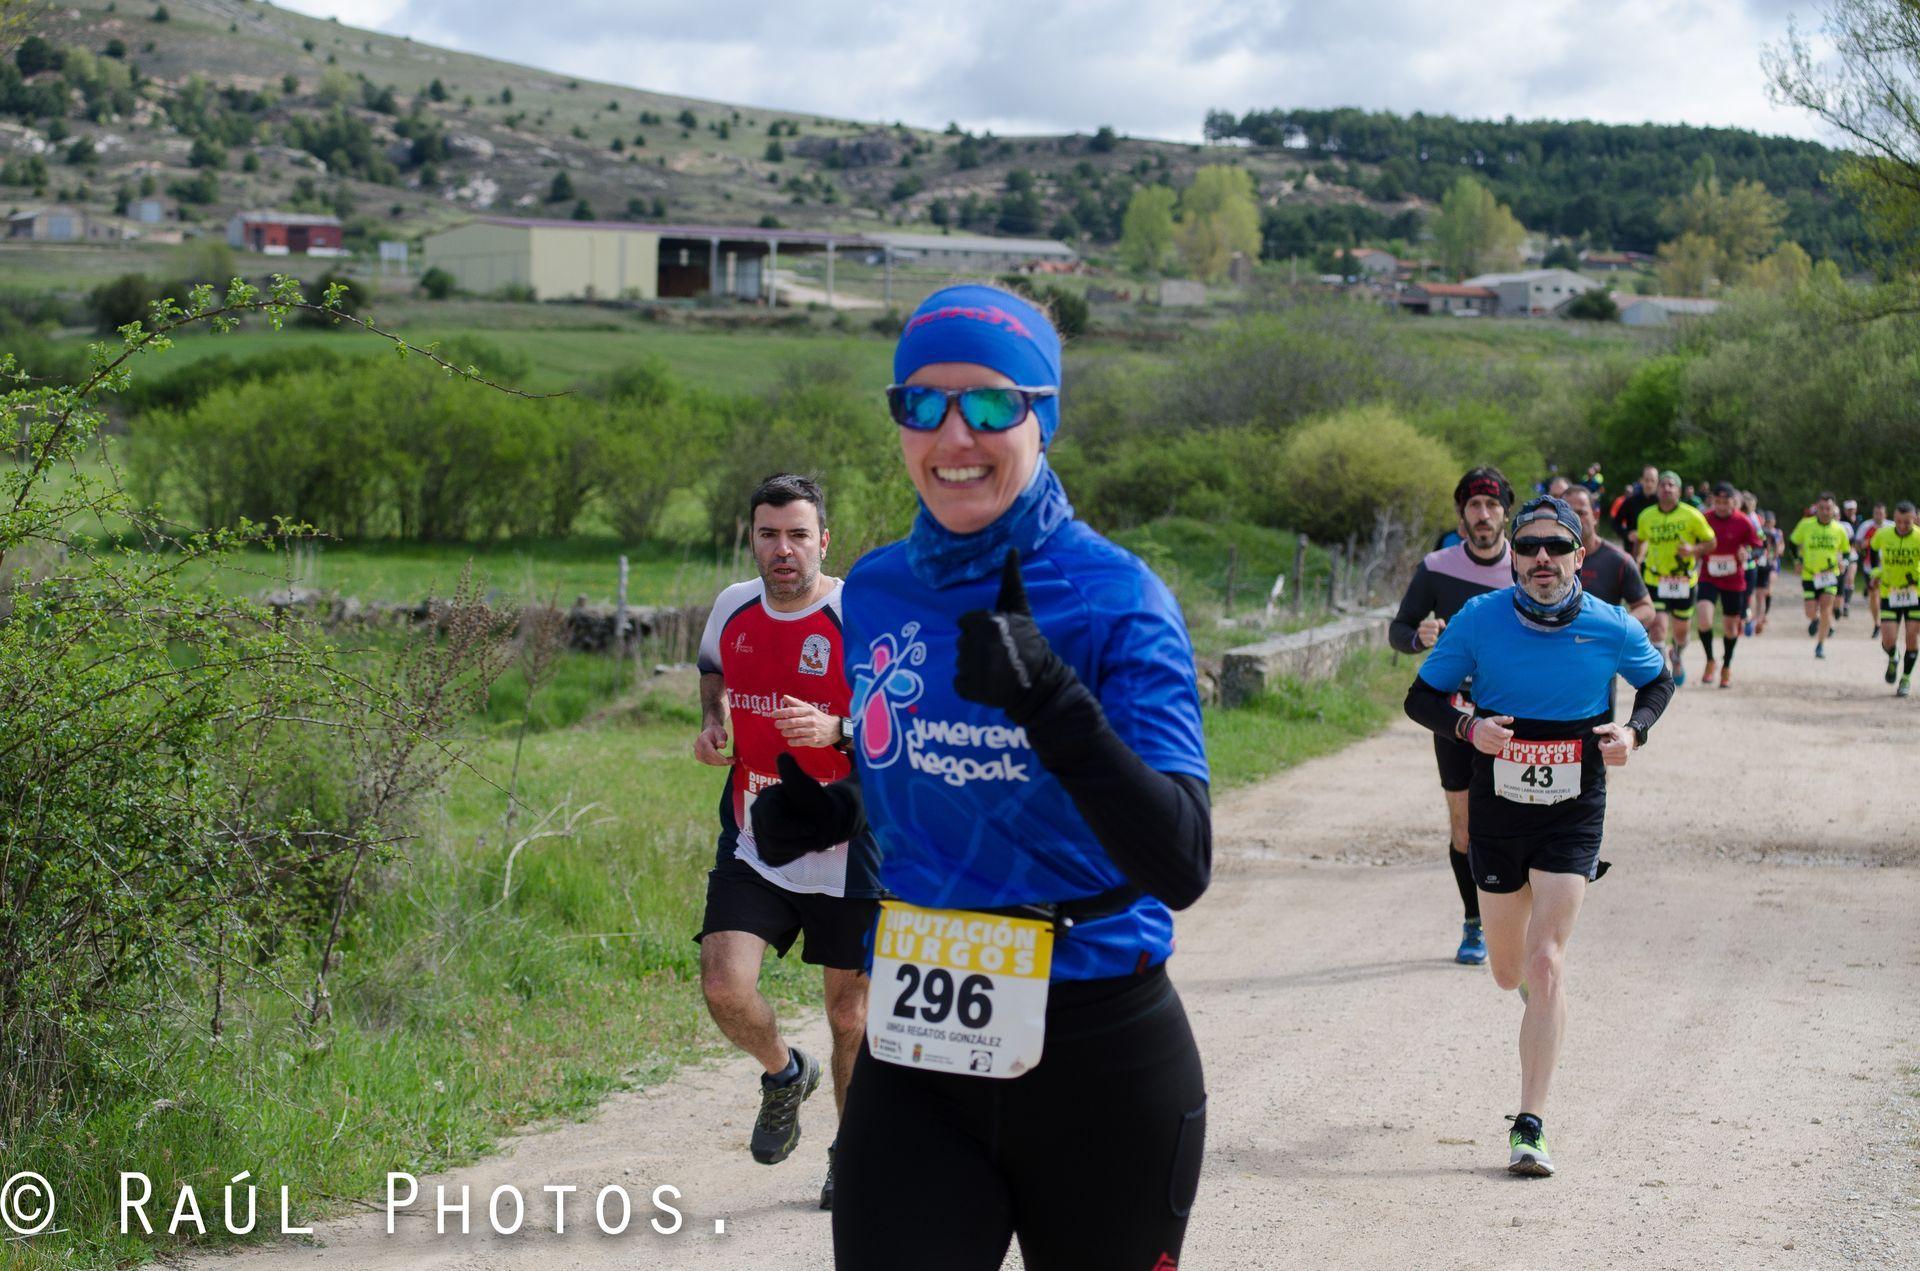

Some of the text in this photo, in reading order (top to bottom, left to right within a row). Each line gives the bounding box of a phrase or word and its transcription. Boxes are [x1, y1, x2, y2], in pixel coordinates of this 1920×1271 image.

[907, 731, 1030, 787] hegoak
[1503, 749, 1574, 764] BURGOS
[1505, 741, 1575, 754] DIPUTACIÓN
[1521, 766, 1553, 788] 43
[886, 909, 1036, 949] DIPUTACIÓN
[881, 932, 1034, 975] BURGOS
[893, 964, 994, 1029] 296
[907, 1025, 946, 1041] REGATOS
[948, 1031, 1001, 1048] GONZÁLEZ
